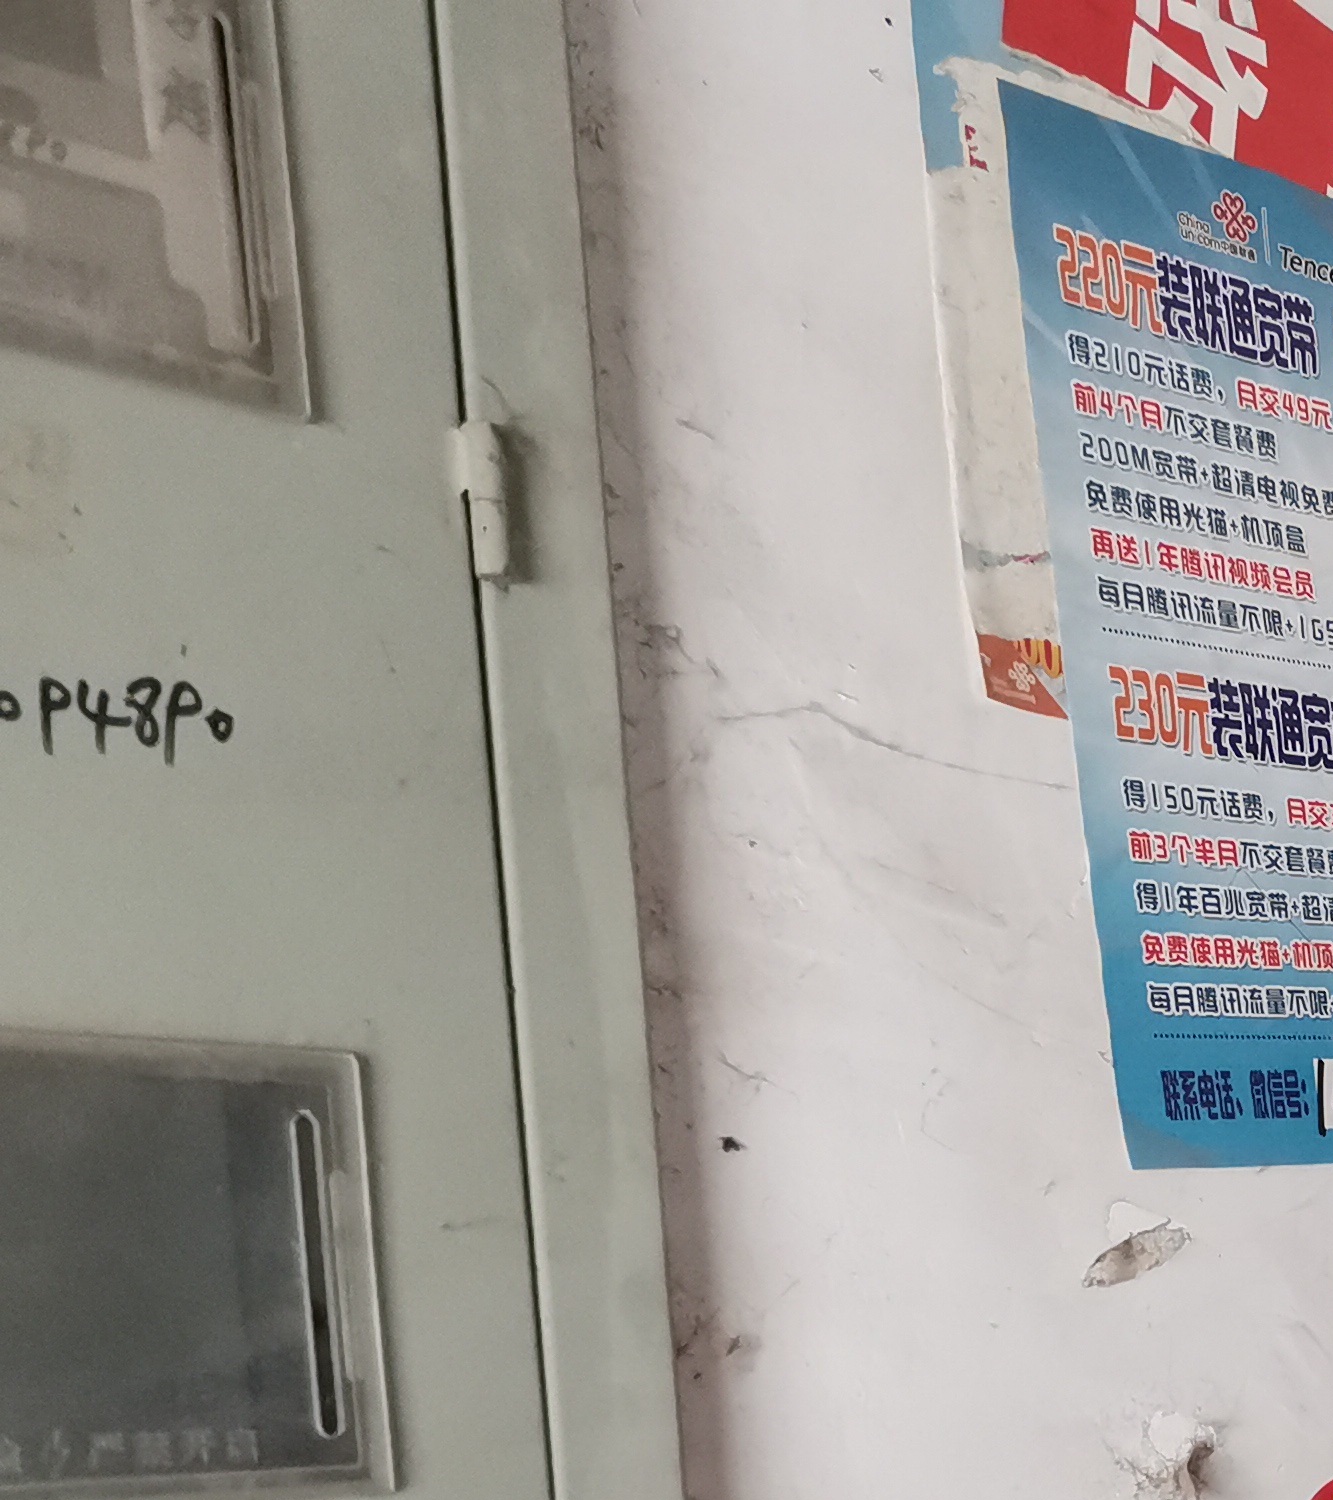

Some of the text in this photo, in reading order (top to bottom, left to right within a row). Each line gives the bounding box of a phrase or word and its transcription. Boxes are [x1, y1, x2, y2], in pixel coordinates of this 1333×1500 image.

[1052, 223, 1321, 378] 220元装联通宽带
[1070, 381, 1278, 463] 前4个月不交套餐费
[1085, 480, 1308, 557] 免费使用光猫+机顶盒
[1089, 528, 1316, 601] 再送1年腾讯视频会员
